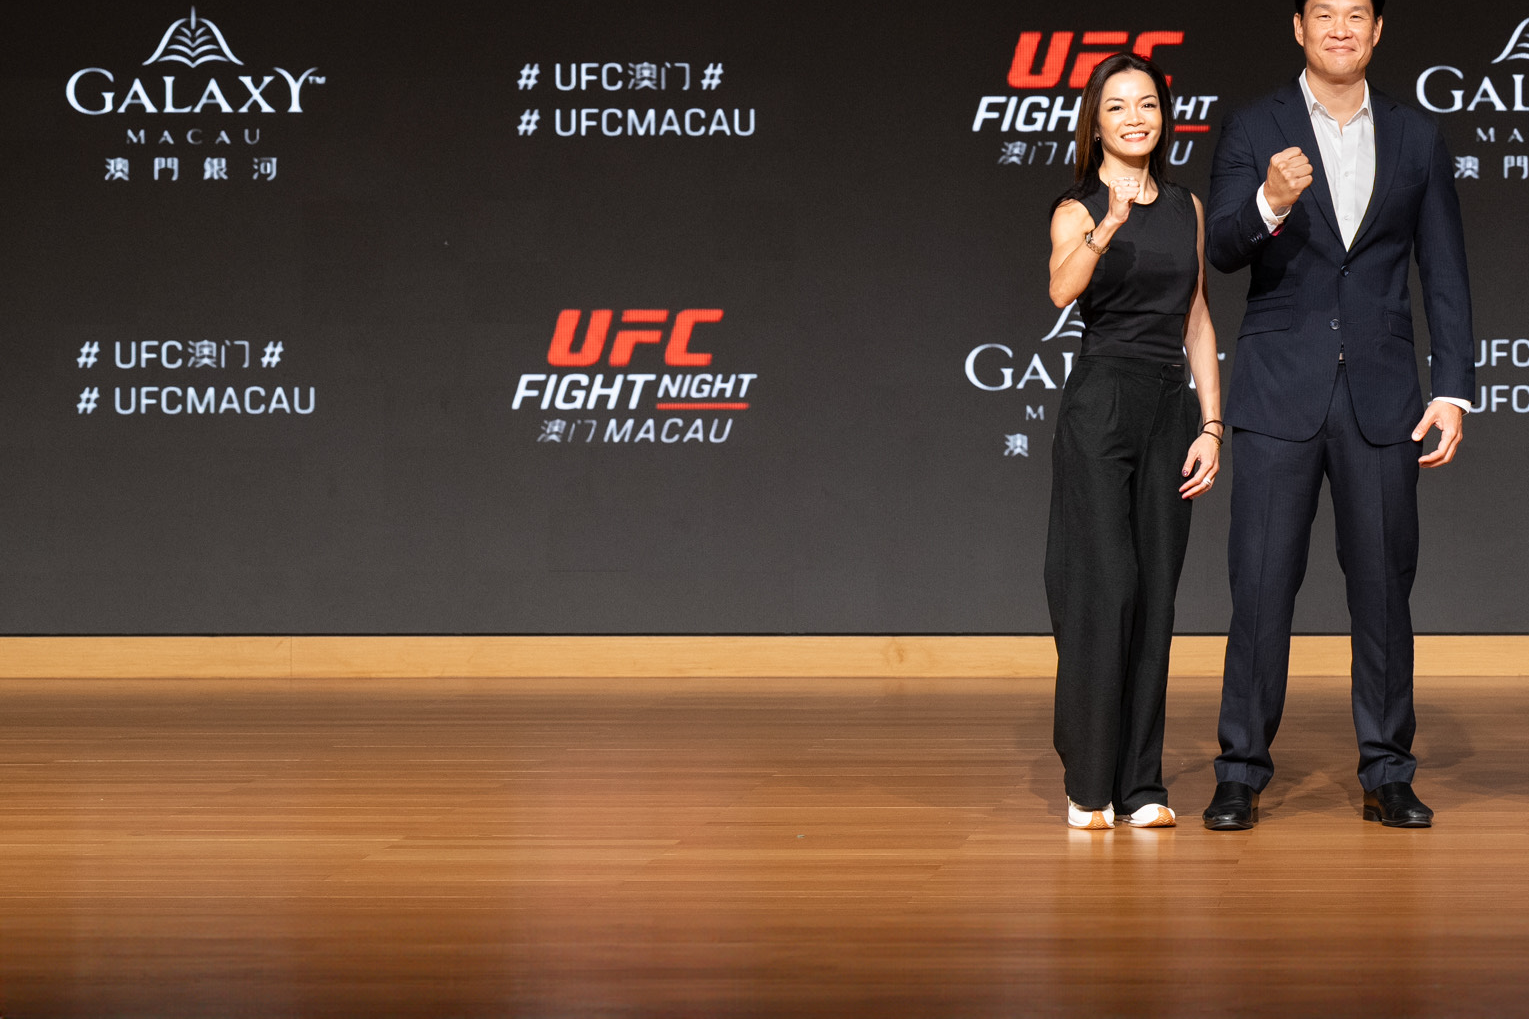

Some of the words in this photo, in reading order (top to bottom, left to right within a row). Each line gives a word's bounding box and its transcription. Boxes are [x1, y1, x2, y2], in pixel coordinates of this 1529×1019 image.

[517, 63, 540, 90] #
[701, 63, 724, 90] #
[517, 109, 540, 136] #
[555, 108, 755, 136] UFCMACAU
[972, 96, 1082, 132] FIGH
[127, 129, 259, 144] MACAU
[999, 141, 1057, 165] 澳门
[105, 157, 277, 181] 澳門銀河
[1454, 155, 1529, 180] 澳門
[547, 309, 724, 367] UFC
[77, 341, 100, 368] #
[261, 341, 284, 368] #
[77, 387, 99, 414] #
[115, 386, 315, 414] UFCMACAU
[512, 374, 656, 410] FIGHT
[657, 374, 757, 398] NIGHT
[538, 419, 597, 442] 澳门
[604, 418, 733, 443] MACAU
